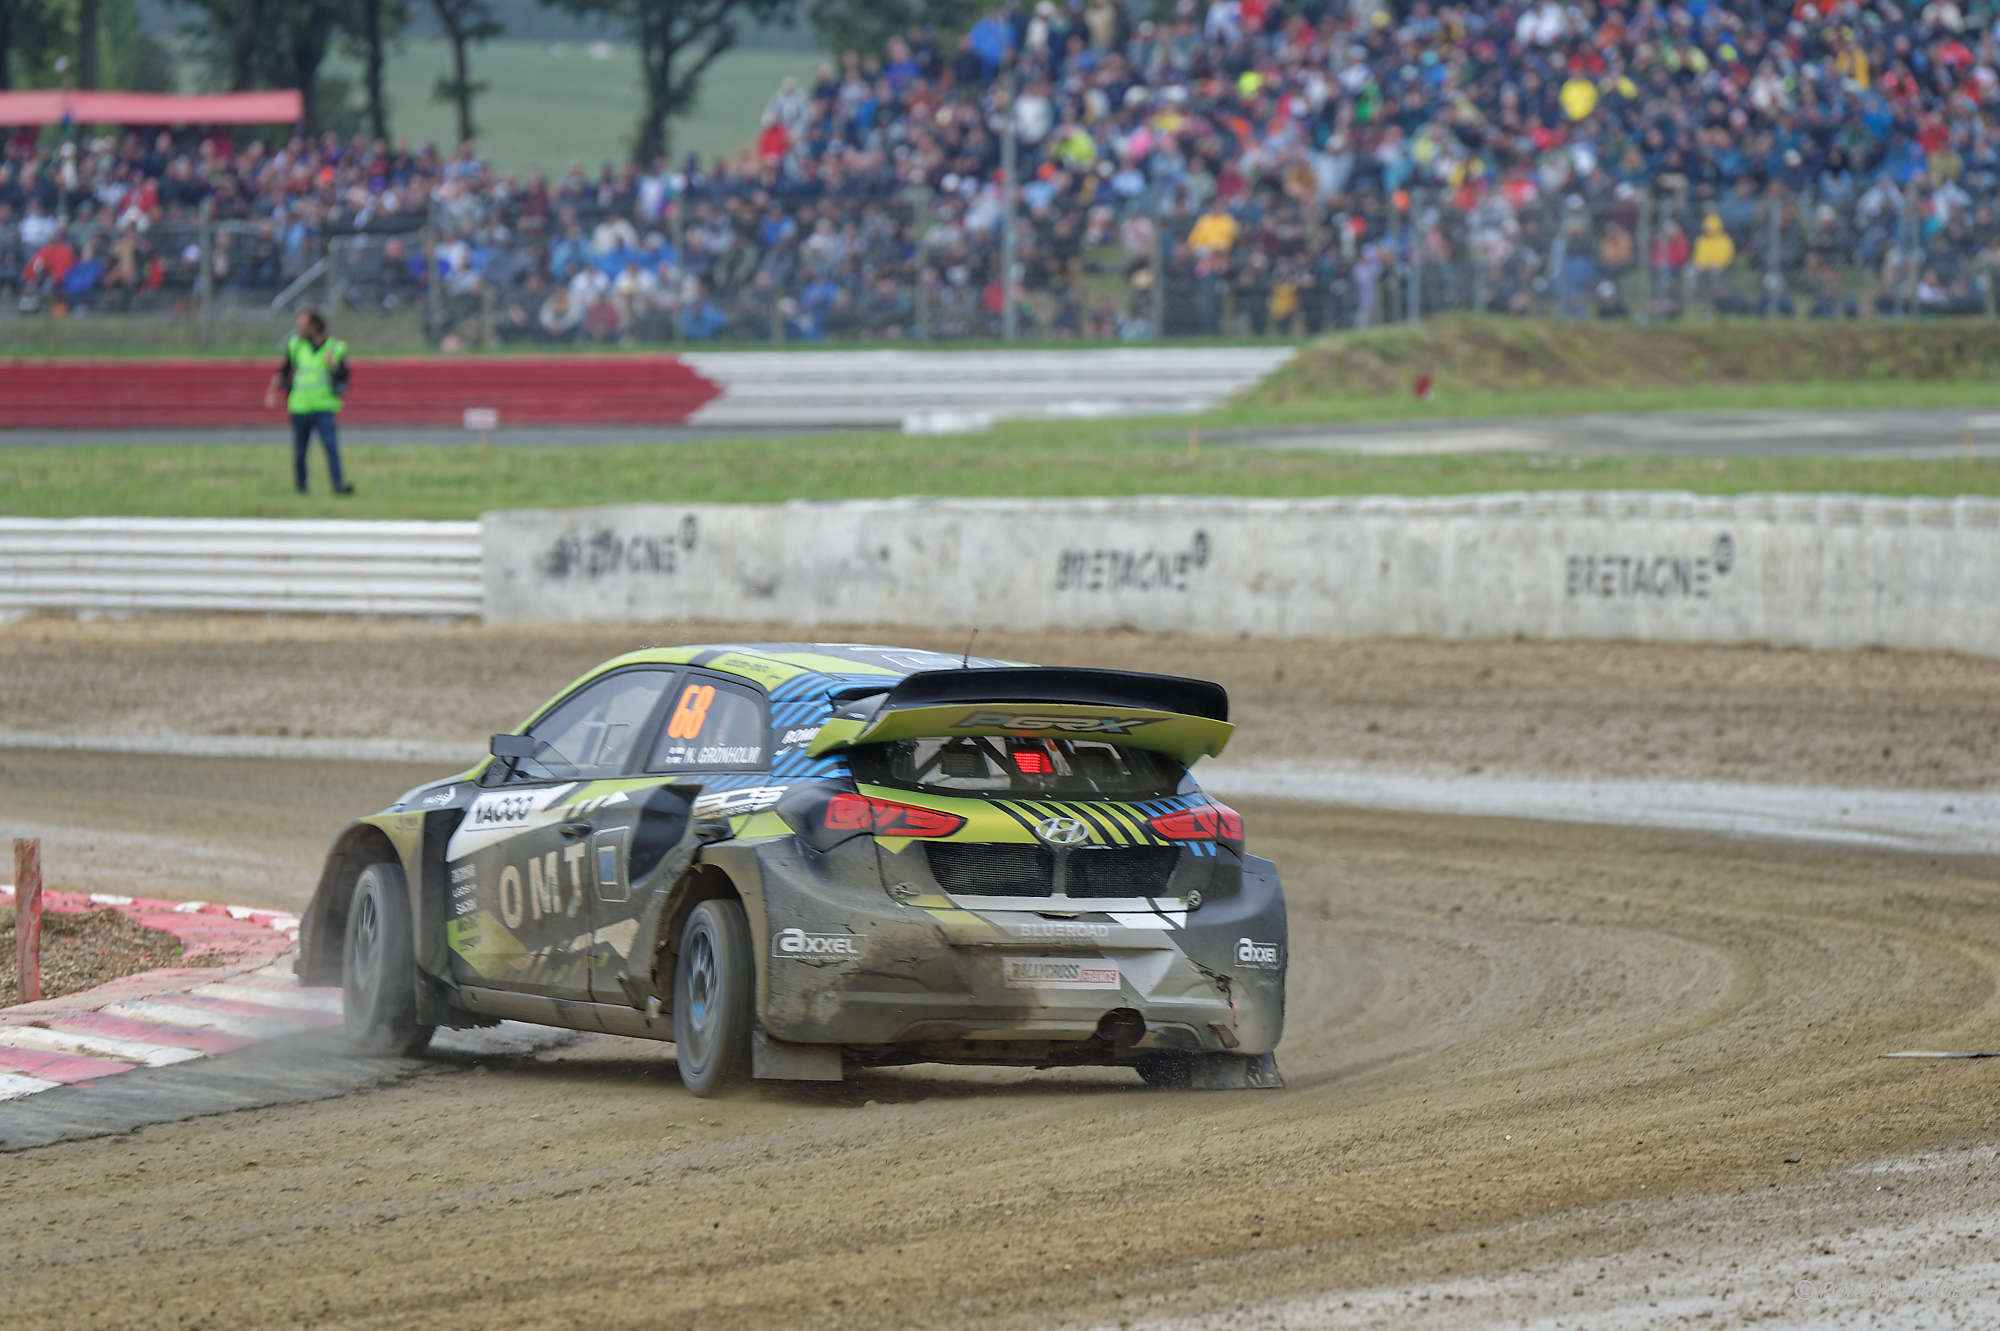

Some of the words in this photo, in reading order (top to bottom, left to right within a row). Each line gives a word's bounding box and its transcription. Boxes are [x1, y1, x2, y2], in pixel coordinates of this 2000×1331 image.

[1057, 549, 1190, 591] BRETAGNE
[1567, 555, 1709, 597] BRETAGNE
[500, 842, 586, 929] OMT
[1021, 923, 1109, 938] BLUEROAD
